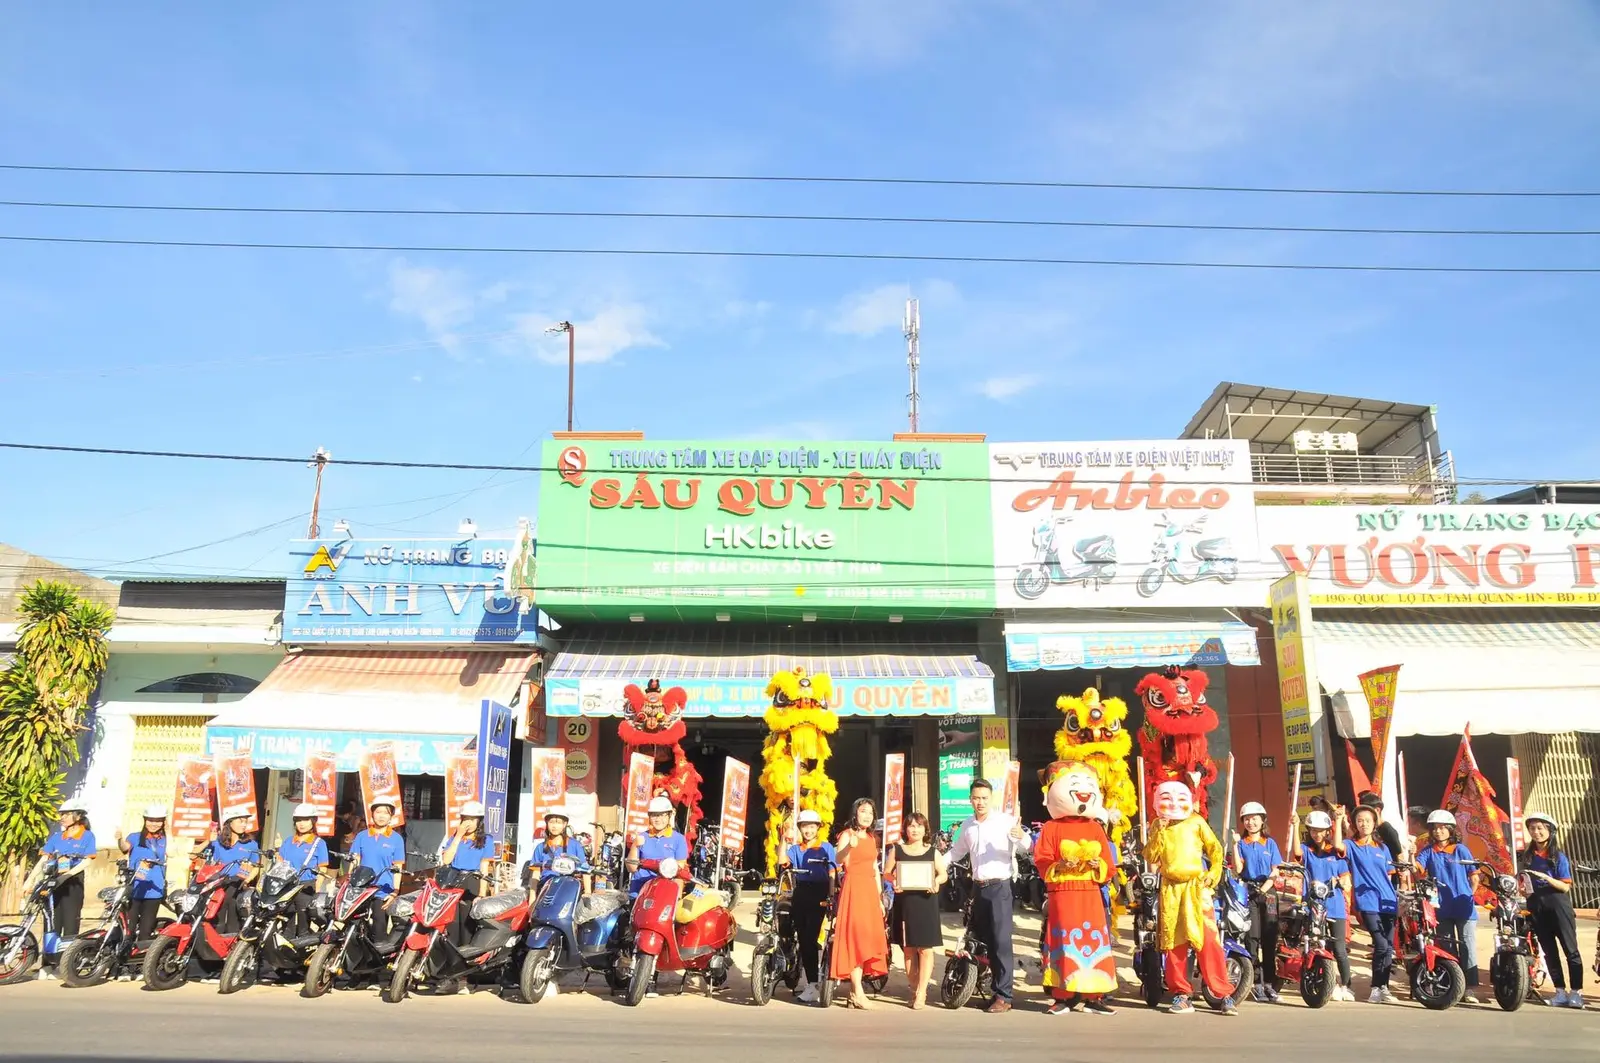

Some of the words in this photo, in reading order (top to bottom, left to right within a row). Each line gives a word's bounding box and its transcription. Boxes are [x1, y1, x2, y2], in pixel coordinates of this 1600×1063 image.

[610, 450, 668, 468] TRUNG
[672, 446, 707, 468] TÂM
[713, 450, 735, 468] XE
[739, 449, 774, 473] ĐẠP
[778, 445, 820, 473] ĐIỆN
[833, 450, 857, 468] XE
[860, 448, 896, 469] MÁY
[900, 447, 942, 475] ĐIỆN
[1041, 451, 1083, 467] TRUNG
[1085, 448, 1112, 467] TÂM
[1115, 451, 1133, 467] XE
[1136, 447, 1168, 470] ĐIỆN
[1170, 446, 1200, 470] VIỆT
[1202, 446, 1235, 470] NHẬT
[589, 471, 702, 510] SÁU
[717, 472, 919, 516] QUYÊN
[1012, 470, 1230, 512] Anbico
[1356, 506, 1405, 532] NỮ
[1417, 512, 1533, 532] TRANG
[363, 543, 396, 566] NỮ
[402, 545, 473, 566] TRANG
[481, 548, 510, 570] BẠ
[1271, 536, 1538, 590] VƯƠNG
[297, 583, 424, 616] ANH
[853, 680, 951, 712] QUYÊN
[568, 723, 587, 735] 20
[1261, 758, 1273, 767] 196
